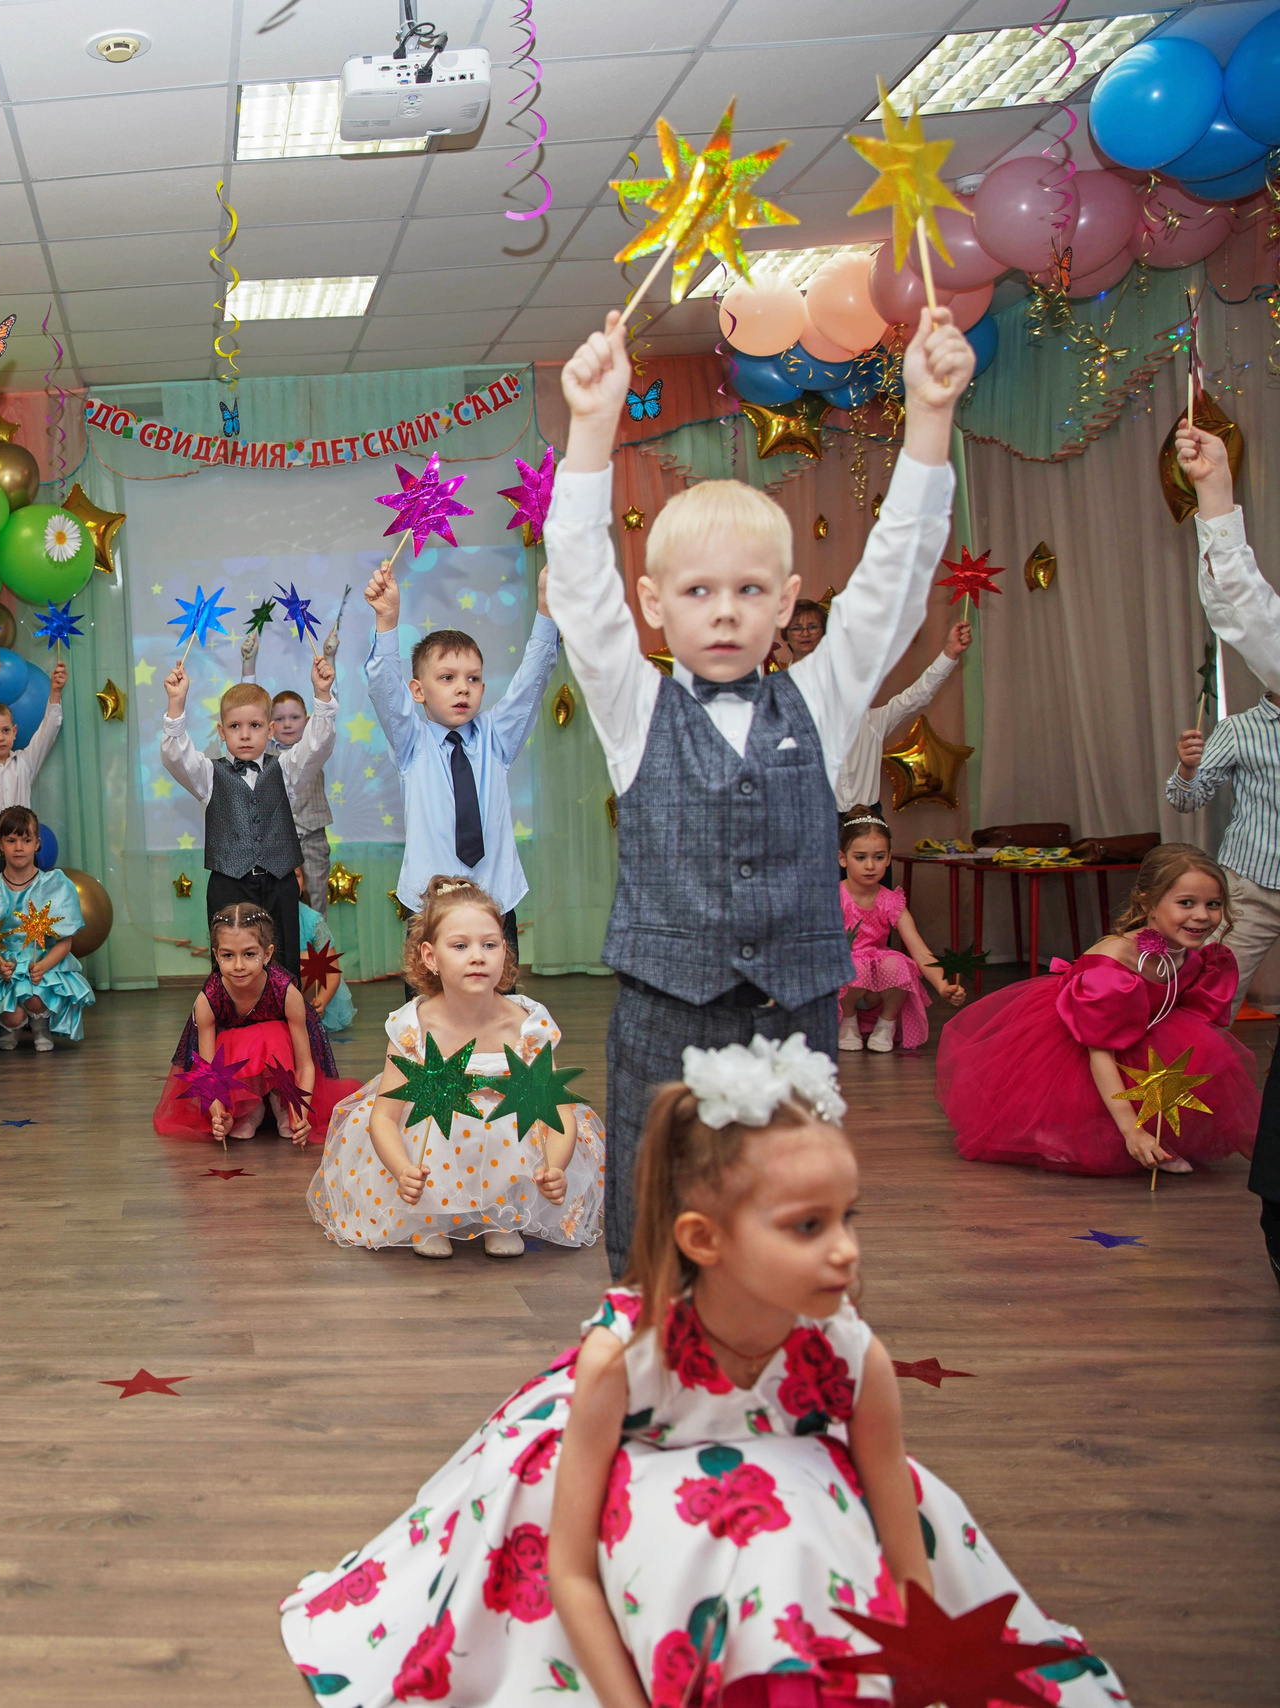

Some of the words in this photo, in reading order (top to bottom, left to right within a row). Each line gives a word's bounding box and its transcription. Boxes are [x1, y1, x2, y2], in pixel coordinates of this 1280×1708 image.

[87, 403, 130, 435] ДО
[139, 423, 293, 469] СВИДАНИЯ,
[310, 413, 439, 468] ДЕТСКИЙ
[453, 375, 520, 427] САД!
